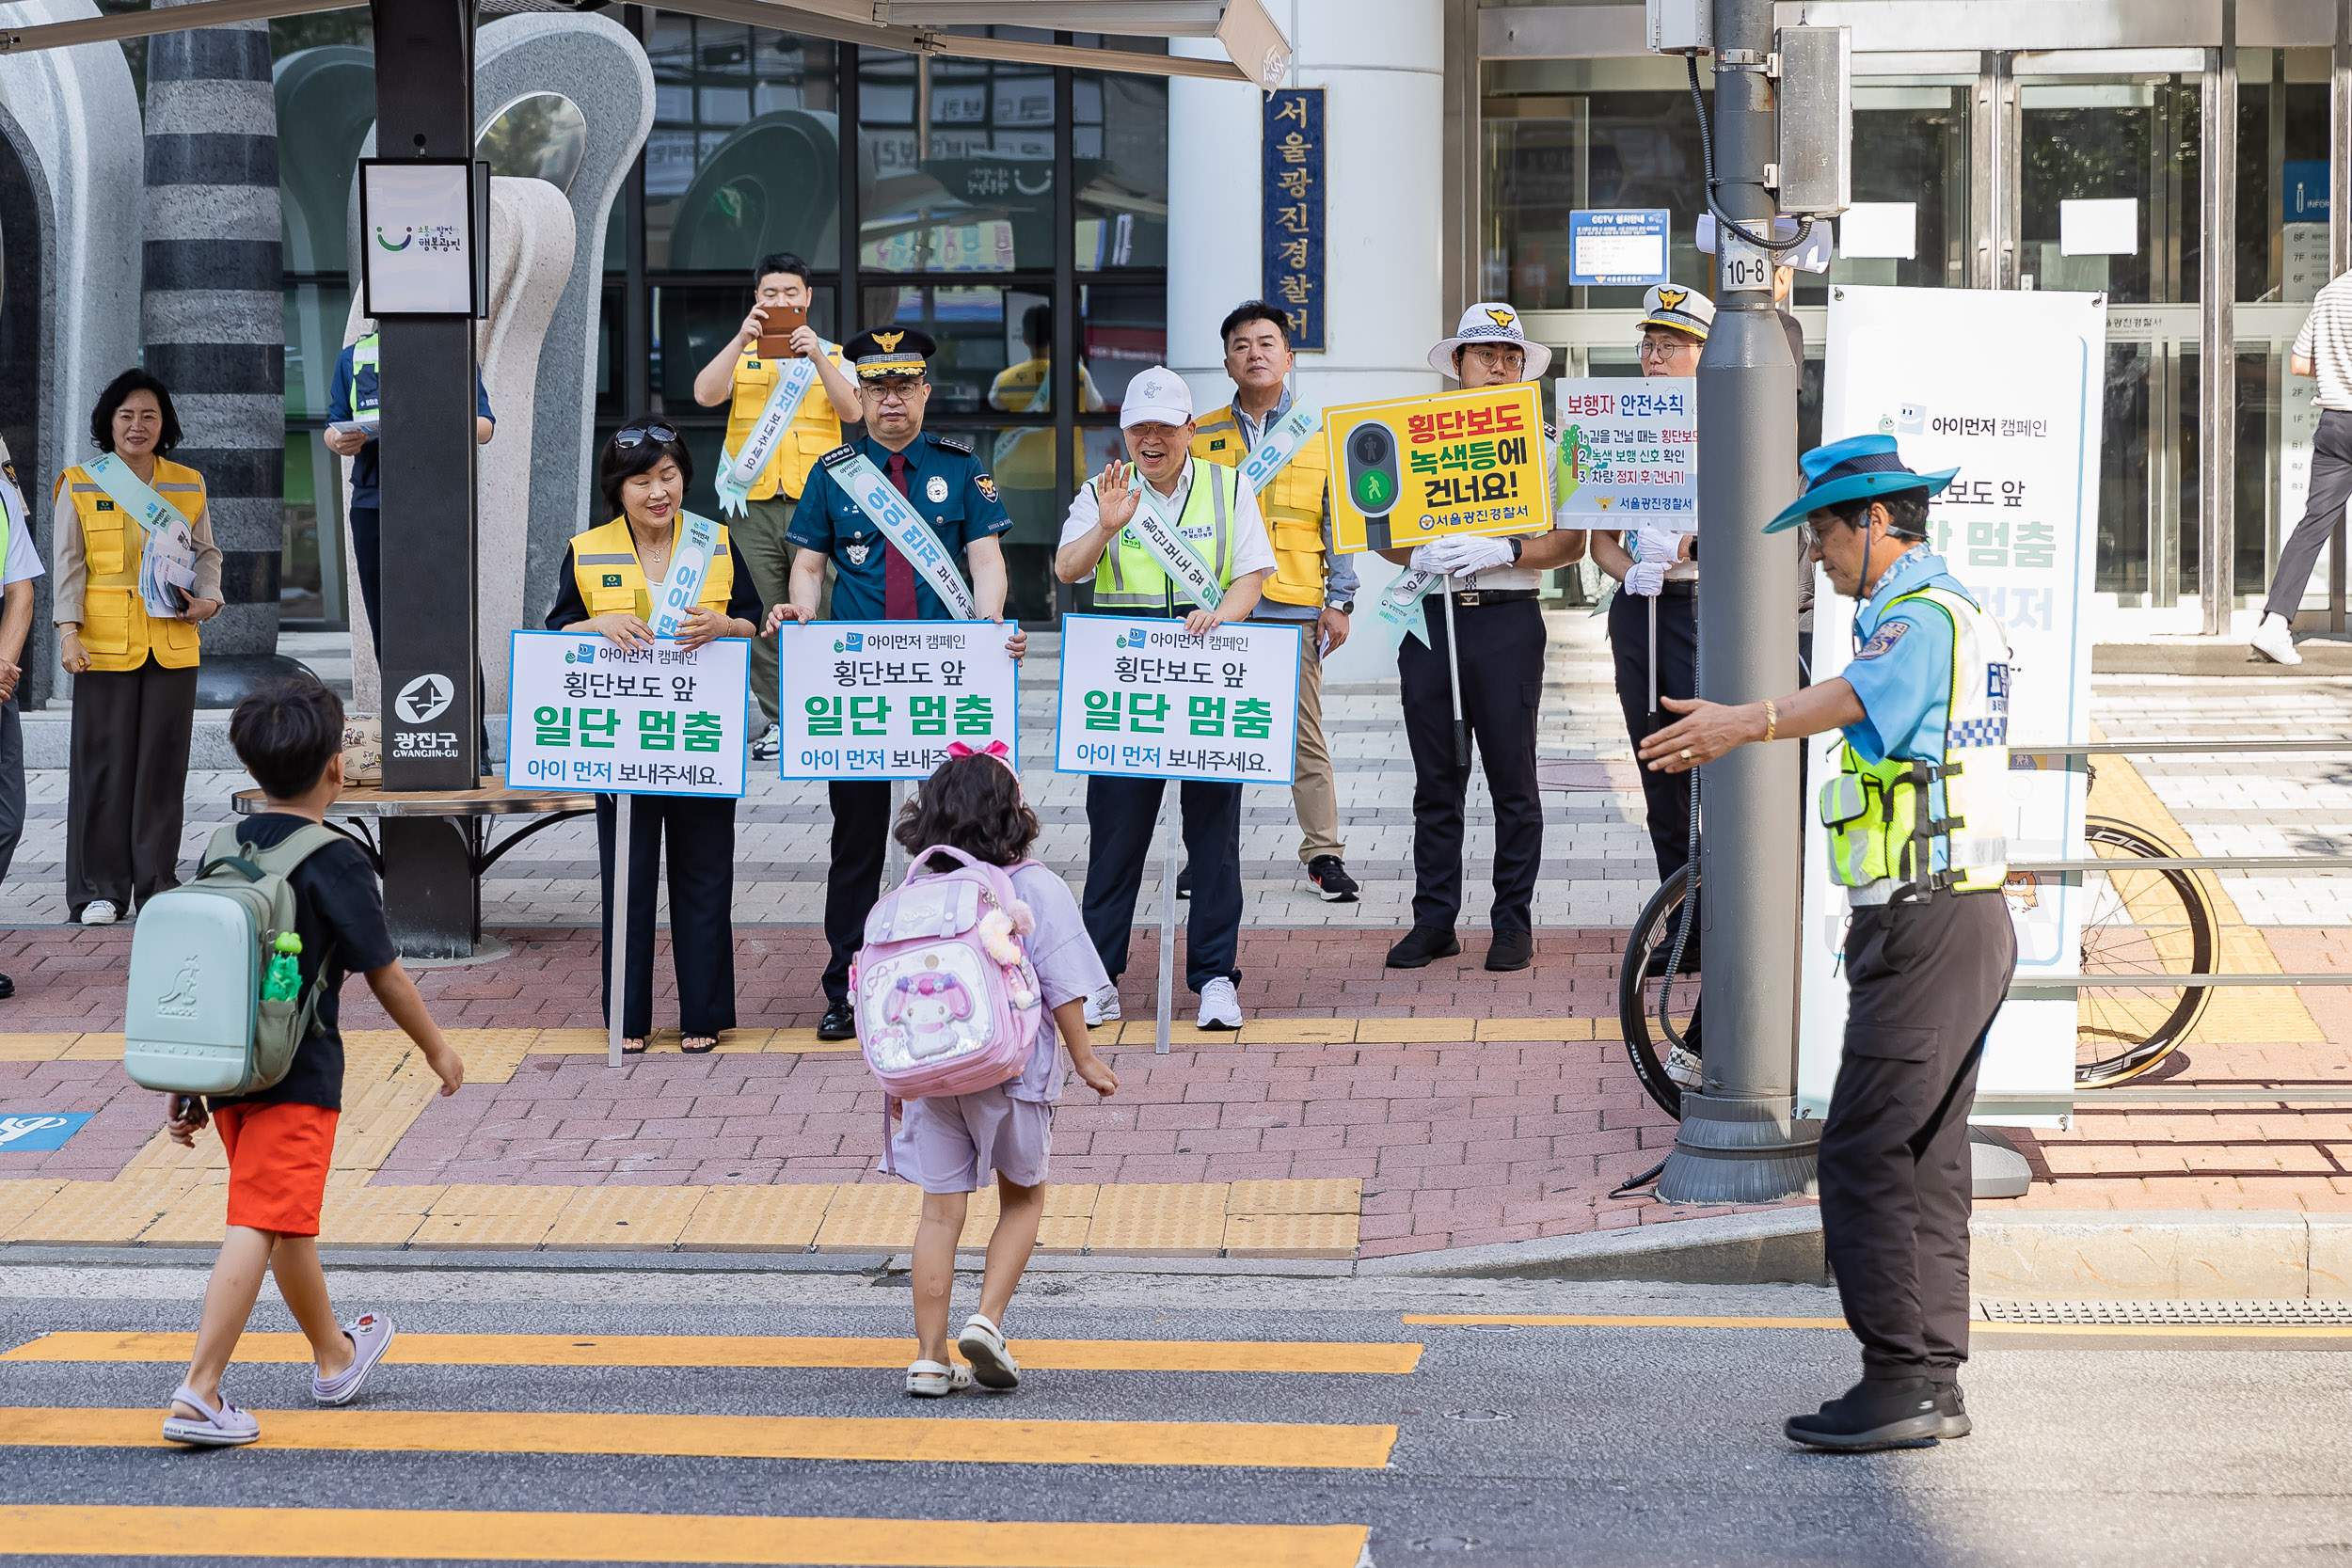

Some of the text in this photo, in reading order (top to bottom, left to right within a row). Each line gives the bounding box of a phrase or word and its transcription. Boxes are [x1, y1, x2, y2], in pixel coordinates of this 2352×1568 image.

[1274, 97, 1312, 341] 서울광진경찰서
[1591, 214, 1613, 225] CCTV
[419, 237, 460, 252] 행복광진
[1728, 259, 1765, 285] 10-8
[1567, 394, 1683, 417] 보행자 안전수칙
[1407, 404, 1524, 444] 횡단보도
[1578, 430, 1587, 444] 1.
[1590, 430, 1610, 444] 길을
[1613, 430, 1634, 444] 건널
[1637, 430, 1658, 444] 때는
[1932, 417, 2047, 437] 아이먼저 캠페인
[1247, 446, 1281, 482] 아이
[1410, 436, 1528, 475] 녹색등에
[1579, 449, 1685, 464] 2. 녹색 보행 신호 확인
[1424, 471, 1518, 508] 건너요!
[1579, 470, 1684, 484] 3. 차량 정지 후 건너기
[1620, 497, 1692, 511] 서울광진경찰서
[2001, 481, 2026, 507] 앞
[867, 486, 906, 527] 아이
[901, 525, 941, 567] 먼저
[1437, 505, 1529, 527] 서울광진경찰서
[1141, 516, 1192, 573] 횡단보도
[1188, 568, 1205, 586] 앞
[1967, 521, 2056, 568] 멈춤
[668, 566, 697, 611] 아이
[867, 634, 966, 650] 아이먼저 캠페인
[1151, 632, 1249, 653] 아이먼저 캠페인
[599, 647, 698, 666] 아이먼저 캠페인
[834, 660, 966, 687] 횡단보도 앞
[1114, 657, 1248, 689] 횡단보도 앞
[564, 672, 697, 702] 횡단보도 앞
[804, 694, 993, 736] 일단 멈춤
[1084, 690, 1272, 739] 일단 멈춤
[393, 732, 458, 749] 광진구
[533, 706, 723, 752] 일단 멈춤
[801, 749, 839, 770] 아이
[847, 749, 884, 770] 먼저
[1077, 744, 1272, 772] 아이 먼저 보내주세요.
[528, 759, 723, 786] 아이 먼저 보내주세요.
